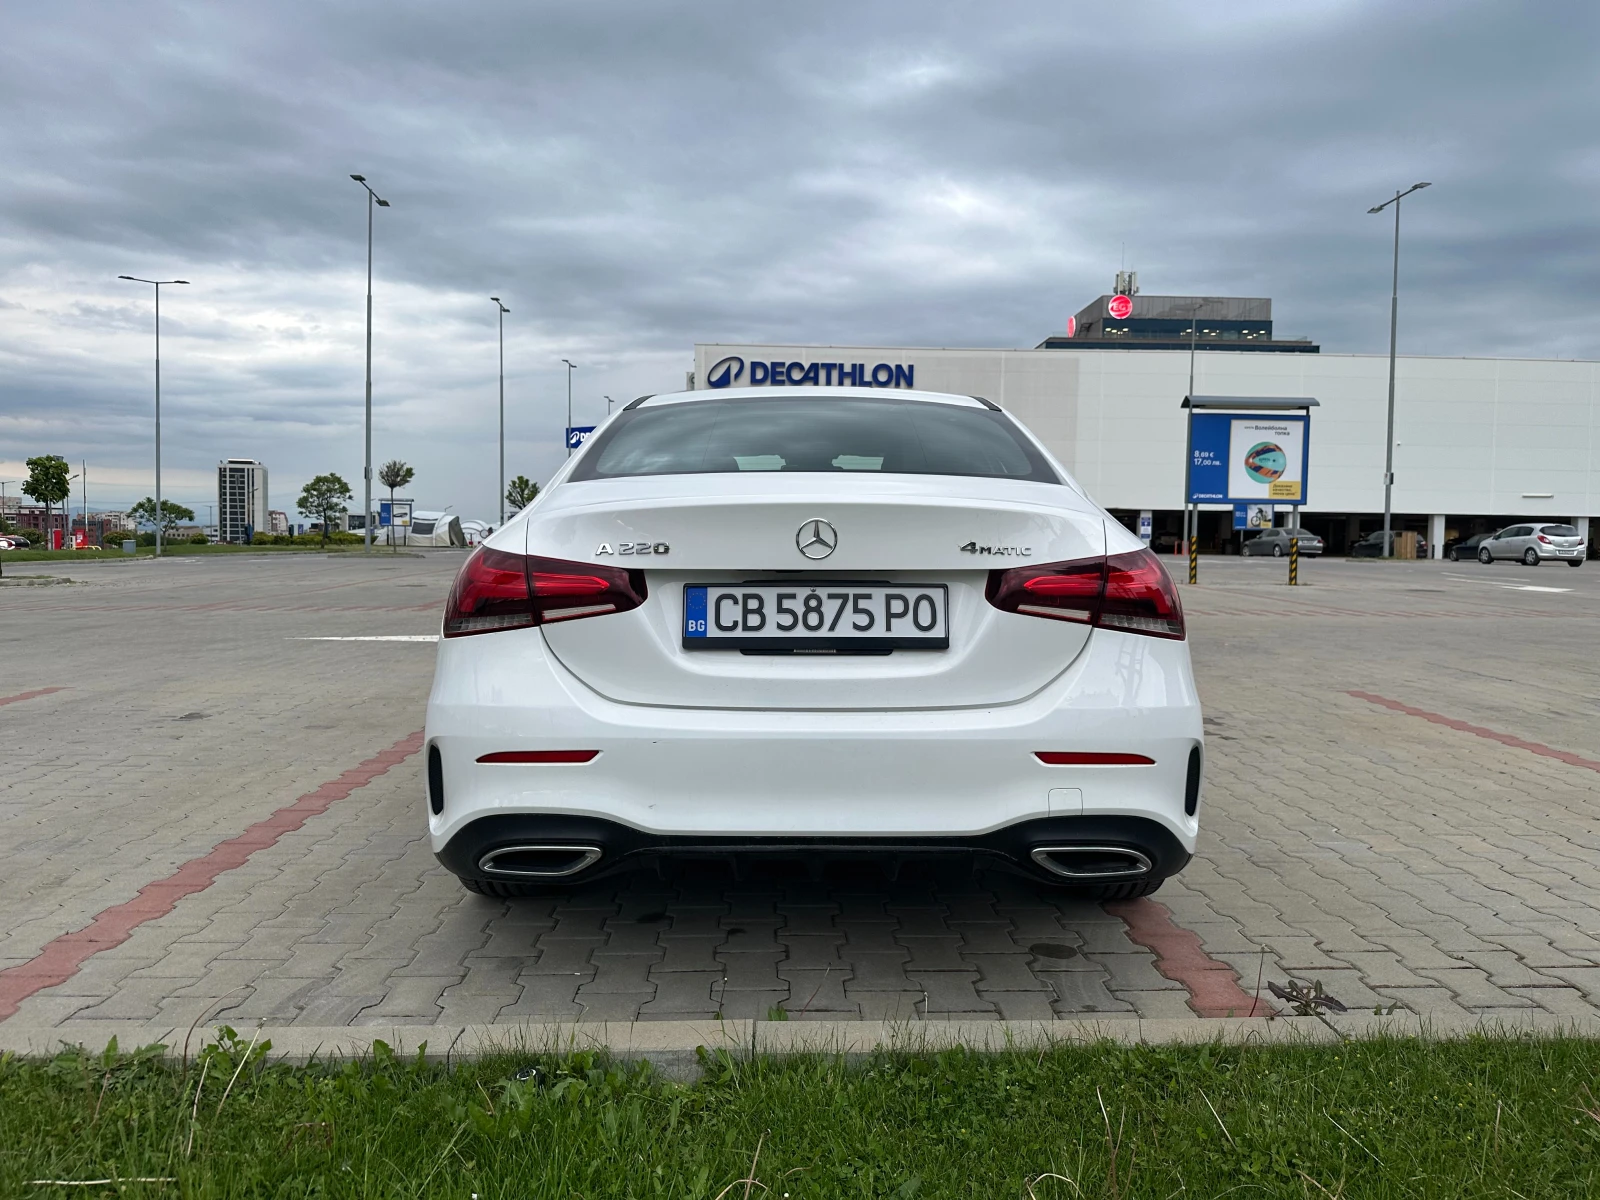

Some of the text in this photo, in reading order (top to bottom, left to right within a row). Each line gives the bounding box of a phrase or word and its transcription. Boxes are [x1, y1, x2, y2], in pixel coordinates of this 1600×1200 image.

[750, 361, 914, 388] DECATHLON
[595, 541, 670, 556] A 220
[960, 541, 1032, 556] 4MATIC
[688, 619, 706, 632] BG
